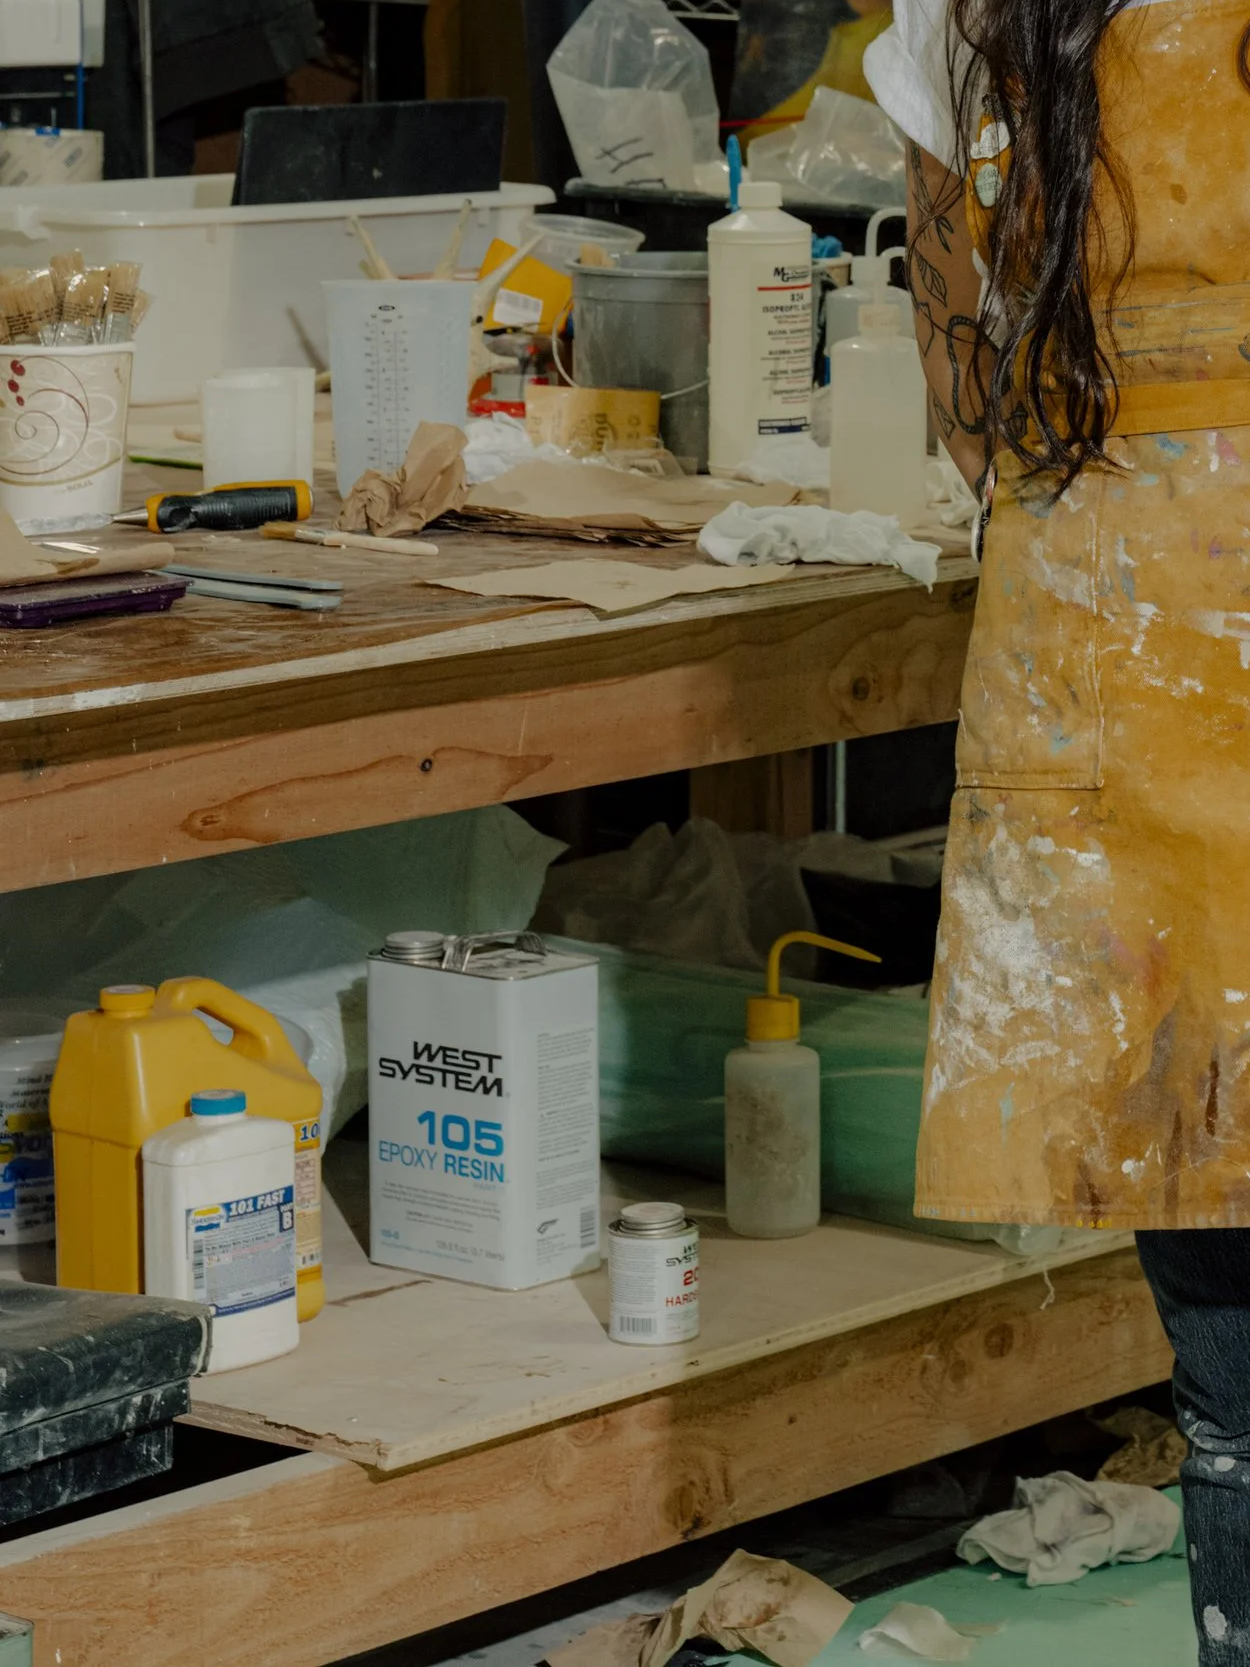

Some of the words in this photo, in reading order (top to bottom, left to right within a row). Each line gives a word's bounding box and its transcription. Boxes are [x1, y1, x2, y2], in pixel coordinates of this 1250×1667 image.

[413, 1041, 502, 1073] WEST
[379, 1057, 503, 1097] SYSTEM
[417, 1110, 504, 1157] 105
[379, 1140, 437, 1171] EPOXY
[444, 1153, 504, 1183] RESIN
[229, 1199, 255, 1217] 101
[257, 1190, 286, 1211] FAST
[282, 1211, 293, 1230] B
